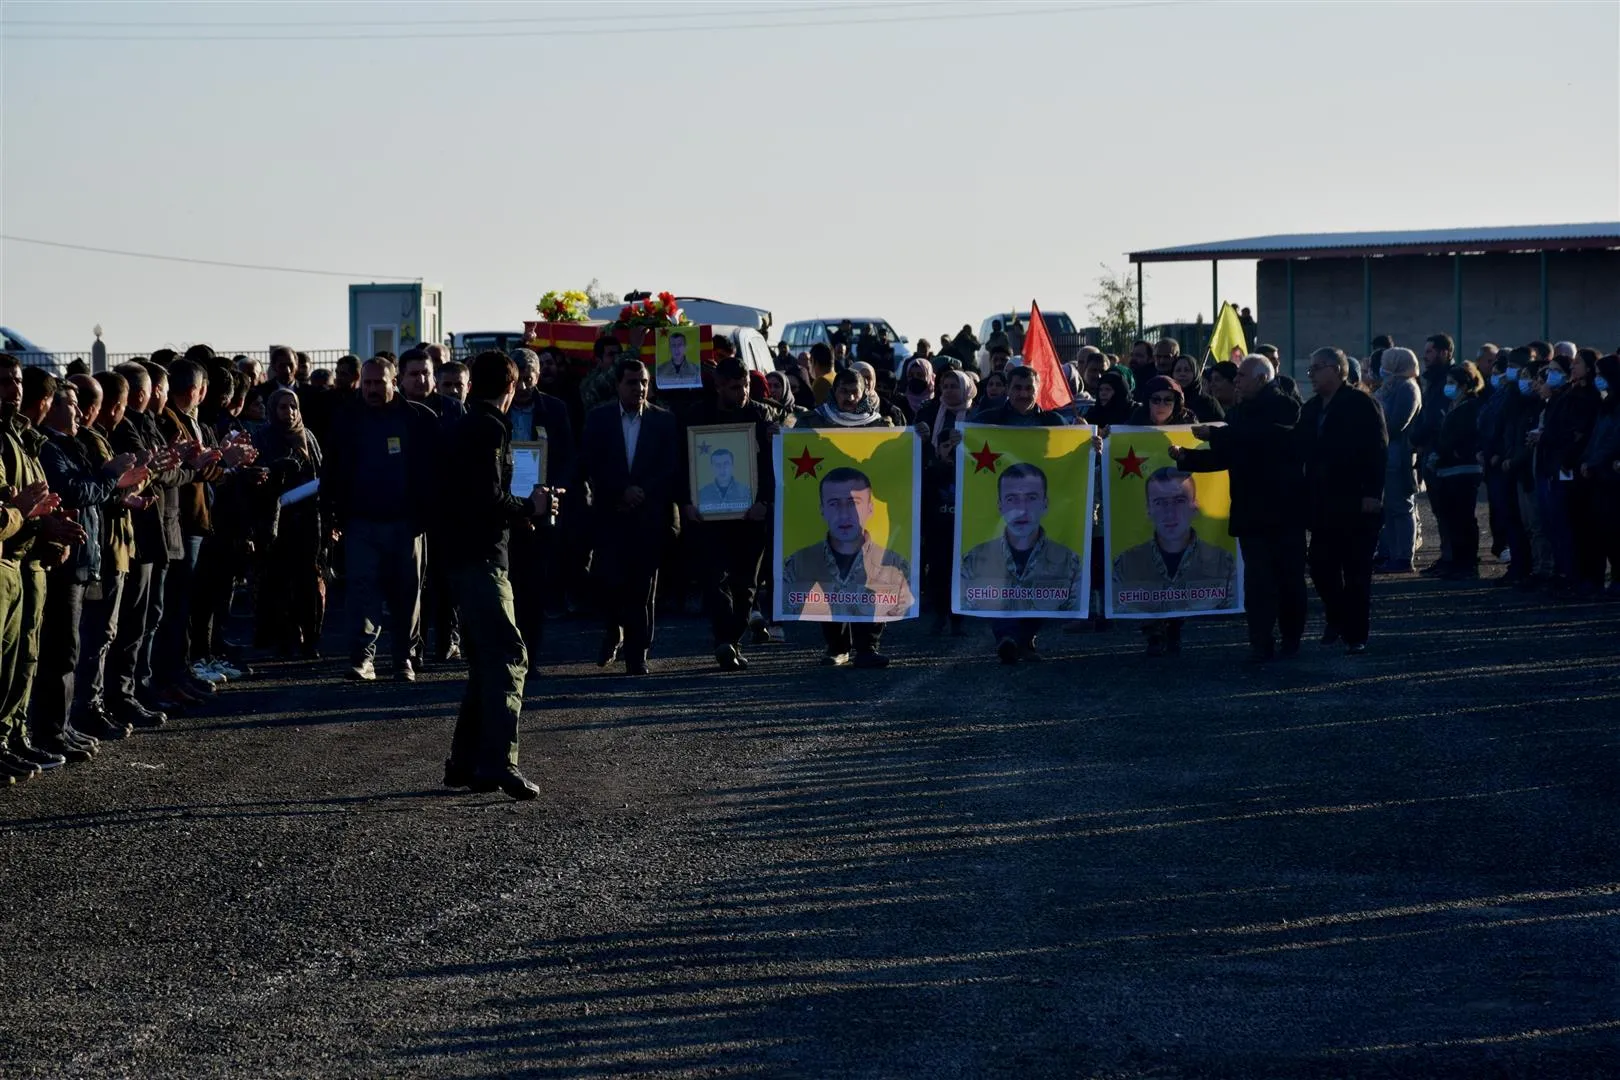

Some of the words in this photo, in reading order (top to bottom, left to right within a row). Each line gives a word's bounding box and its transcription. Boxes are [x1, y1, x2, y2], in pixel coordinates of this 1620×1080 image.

[861, 592, 897, 604] BOTAN
[1036, 588, 1068, 599] BOTAN
[1191, 588, 1225, 599] BOTAN
